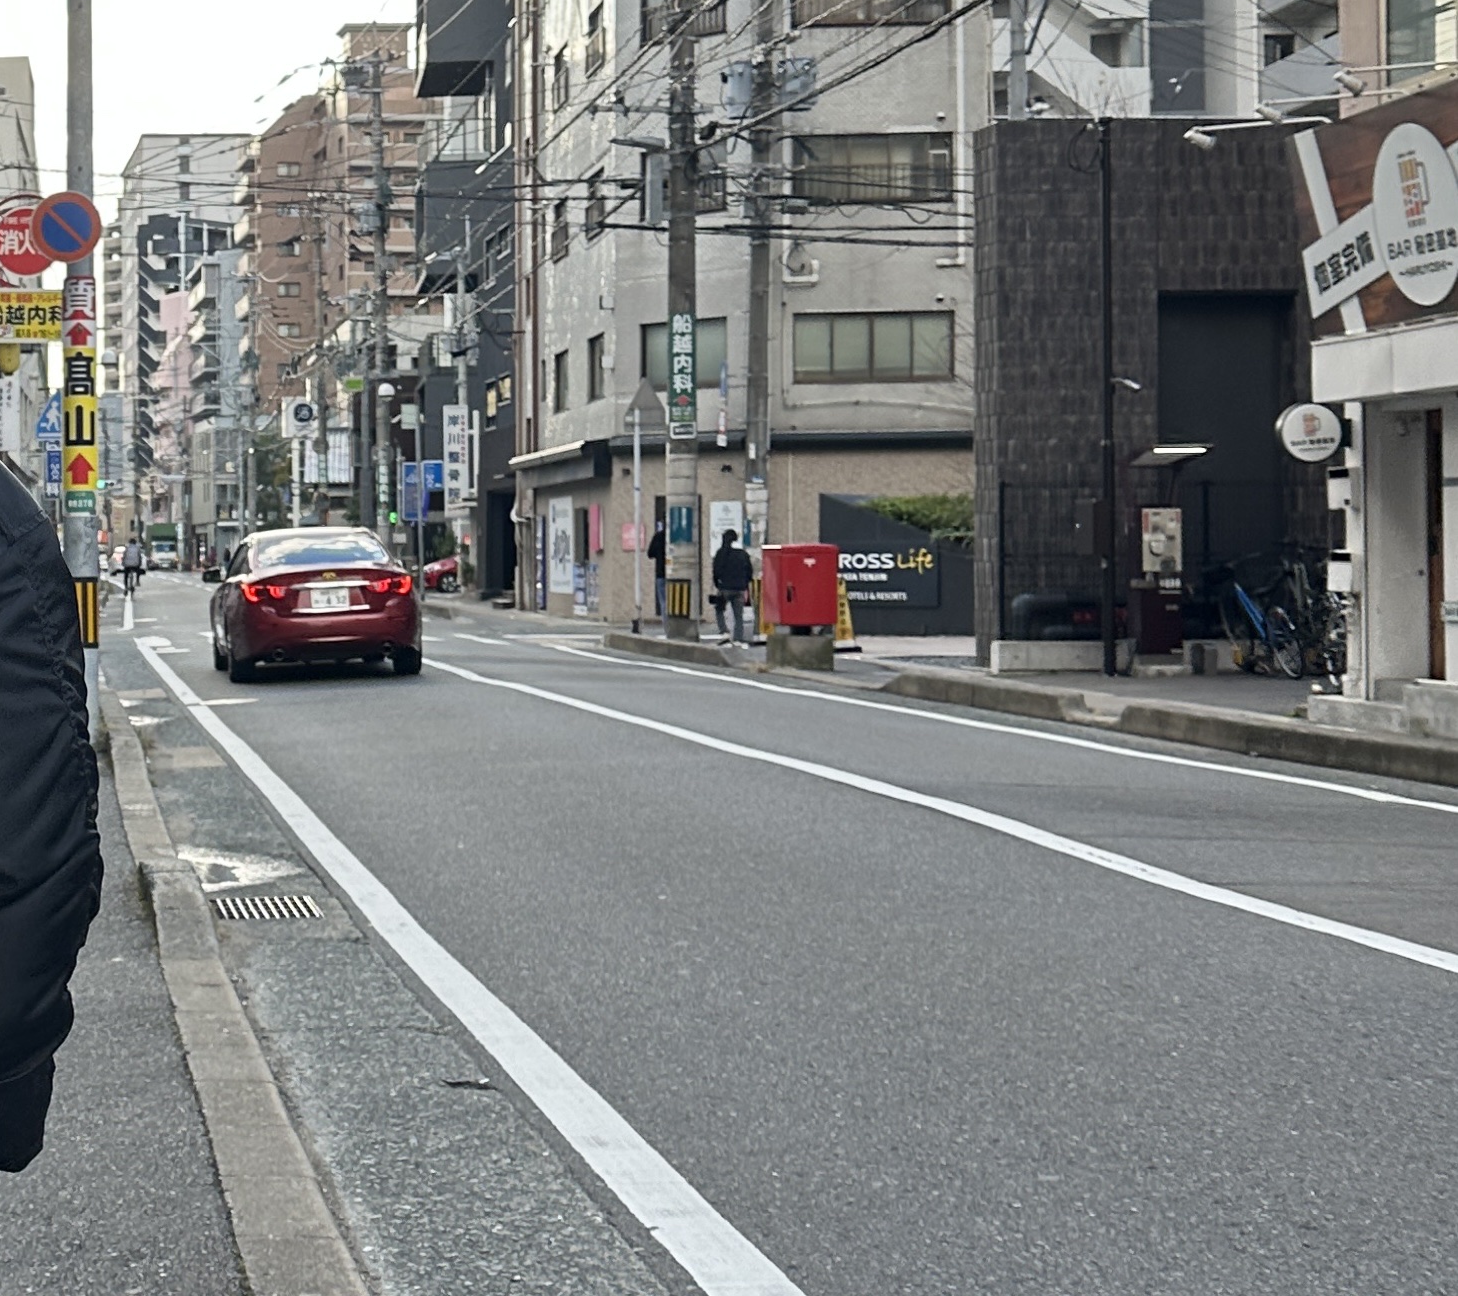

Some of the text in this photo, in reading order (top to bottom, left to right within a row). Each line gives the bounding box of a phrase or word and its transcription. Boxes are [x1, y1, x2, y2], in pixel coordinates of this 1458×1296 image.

[1314, 231, 1375, 295] 個室完備
[1388, 239, 1413, 260] BAR
[672, 313, 693, 394] 船越内科
[838, 548, 934, 575] ROSS Life
